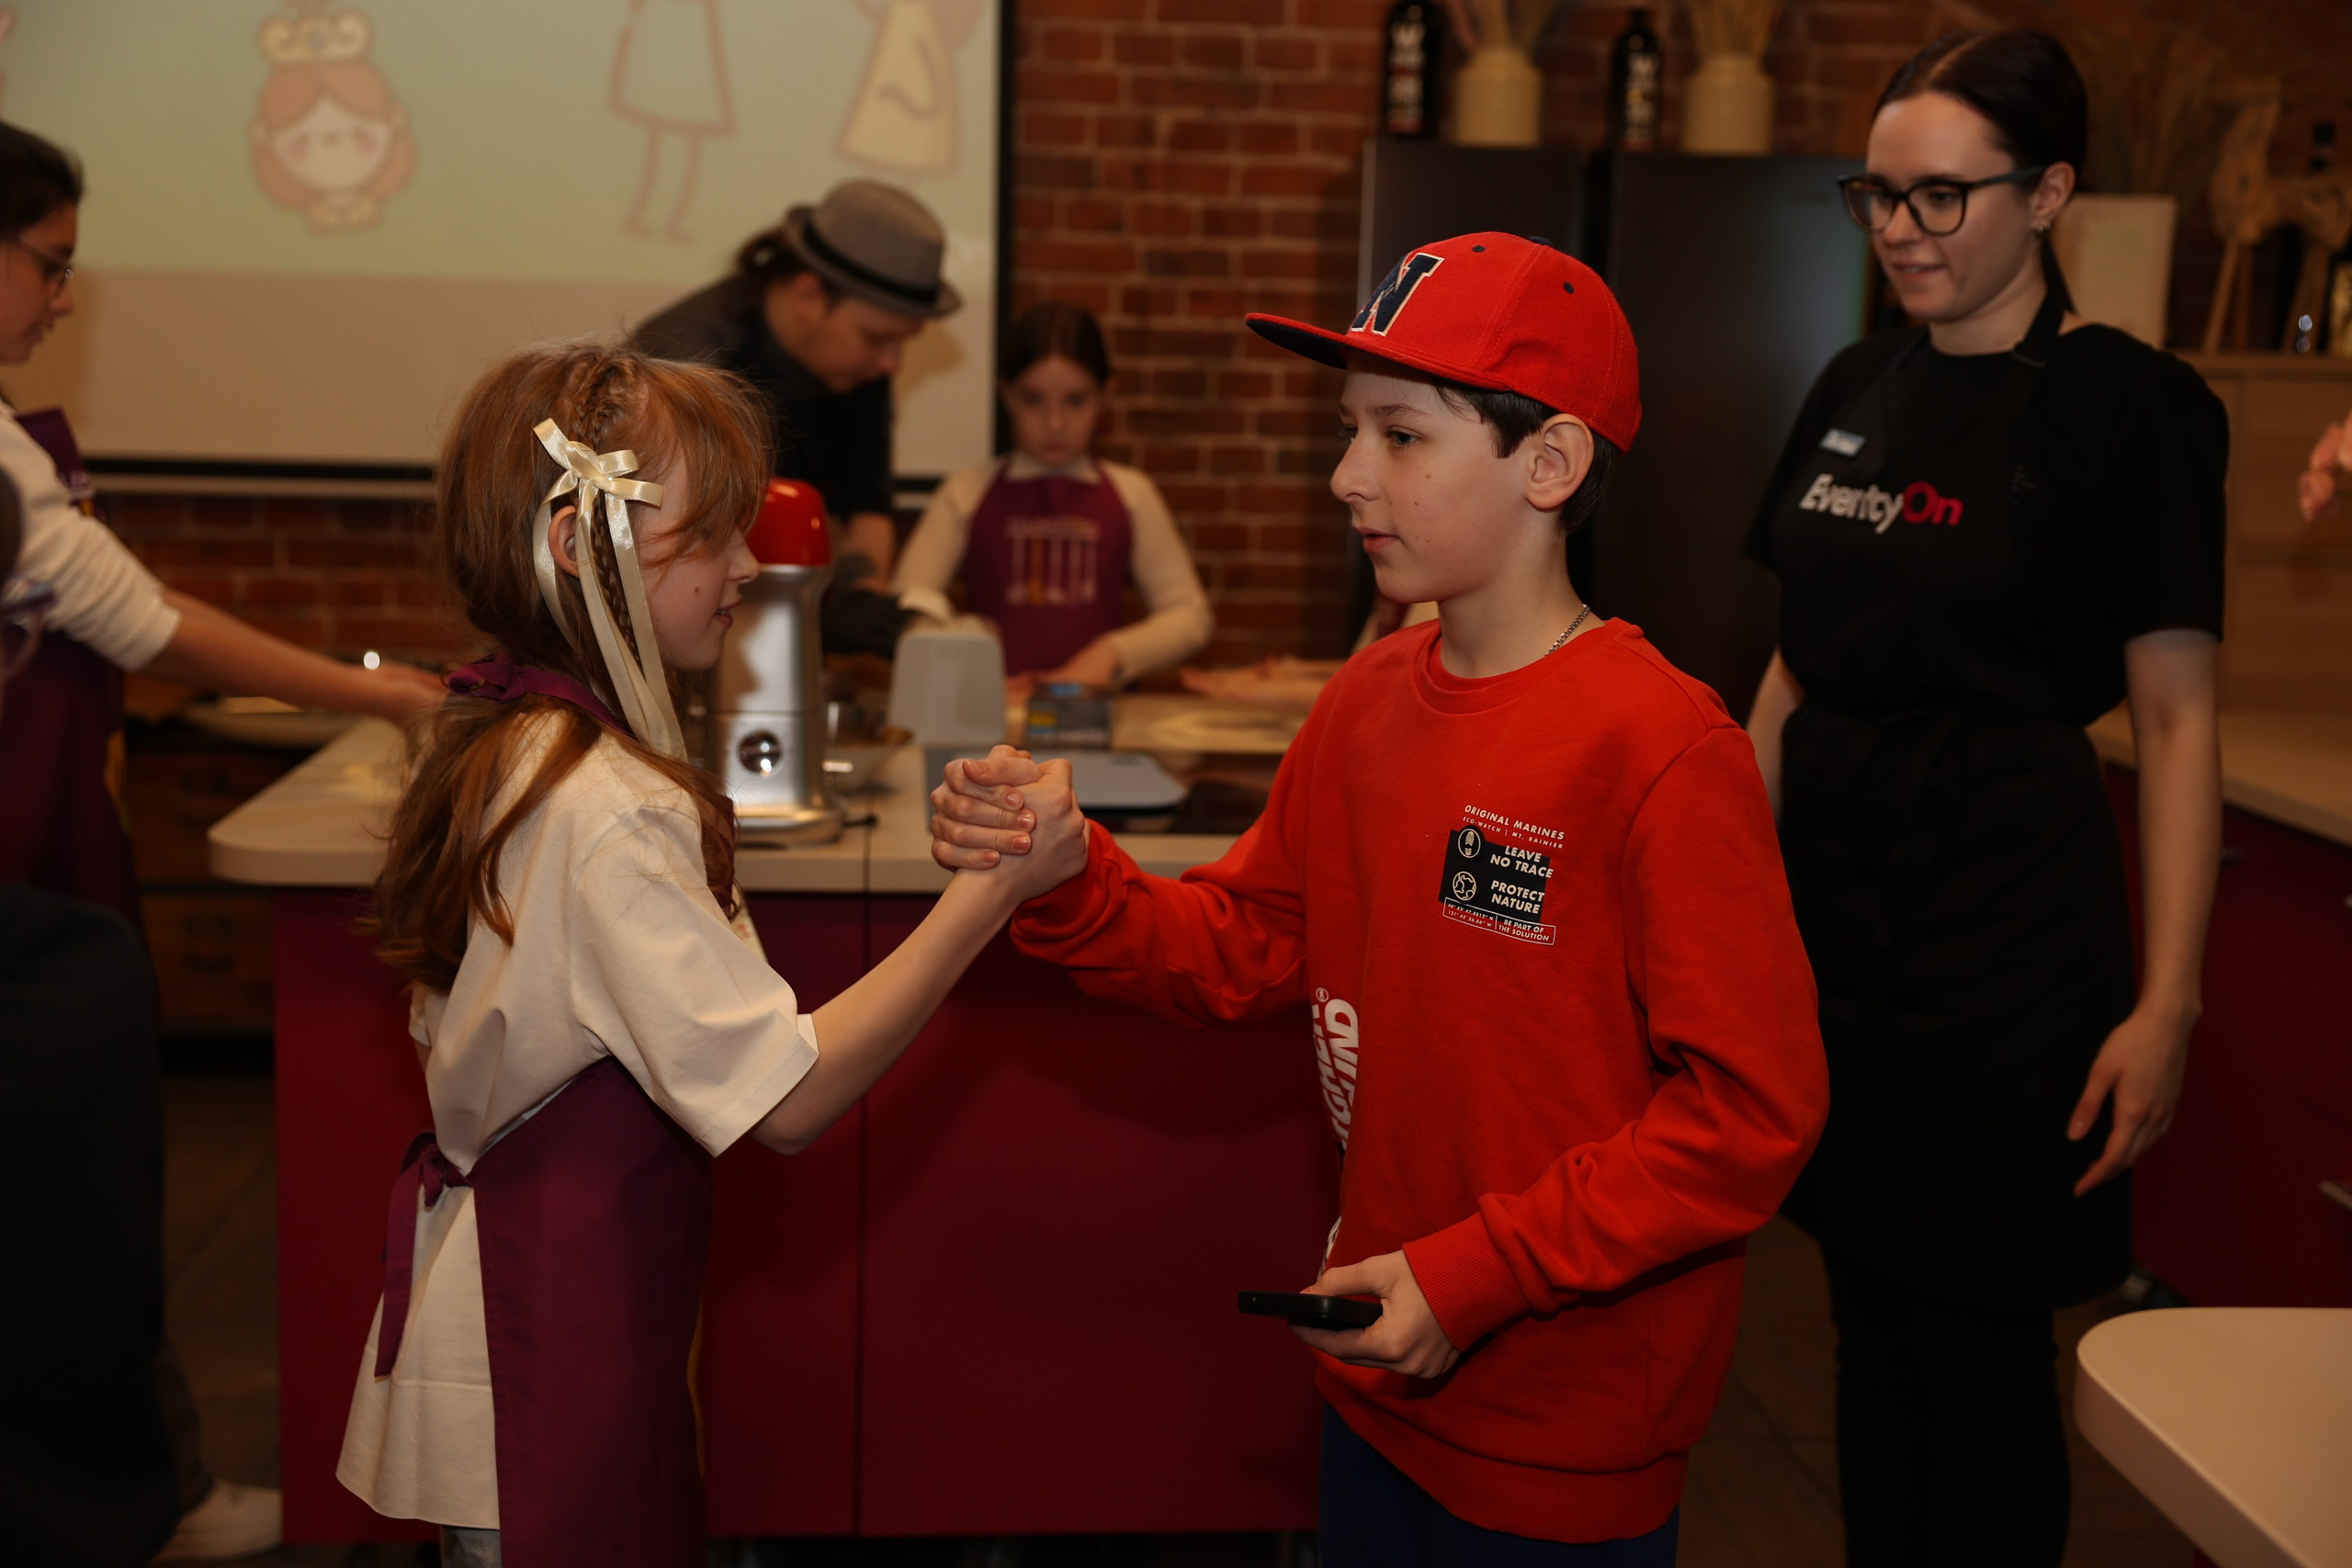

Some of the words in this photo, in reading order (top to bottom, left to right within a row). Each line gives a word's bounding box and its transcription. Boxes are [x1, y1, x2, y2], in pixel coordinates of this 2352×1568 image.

[1798, 473, 1963, 534] EventyOn
[1463, 817, 1501, 833] ECO-WATCH
[1511, 831, 1524, 840] MT.
[1529, 836, 1564, 849] RAINIER
[1464, 805, 1510, 826] ORIGINAL
[1513, 820, 1565, 840] MARINES
[1504, 845, 1542, 863] LEAVE
[1490, 853, 1510, 867] NO
[1515, 861, 1554, 878] TRACE
[1490, 880, 1545, 902] PROTECT
[1491, 893, 1541, 914] NATURE
[1498, 924, 1510, 933] THE
[1511, 929, 1549, 942] SOLUTION
[1503, 919, 1512, 927] BE
[1513, 921, 1532, 931] PART
